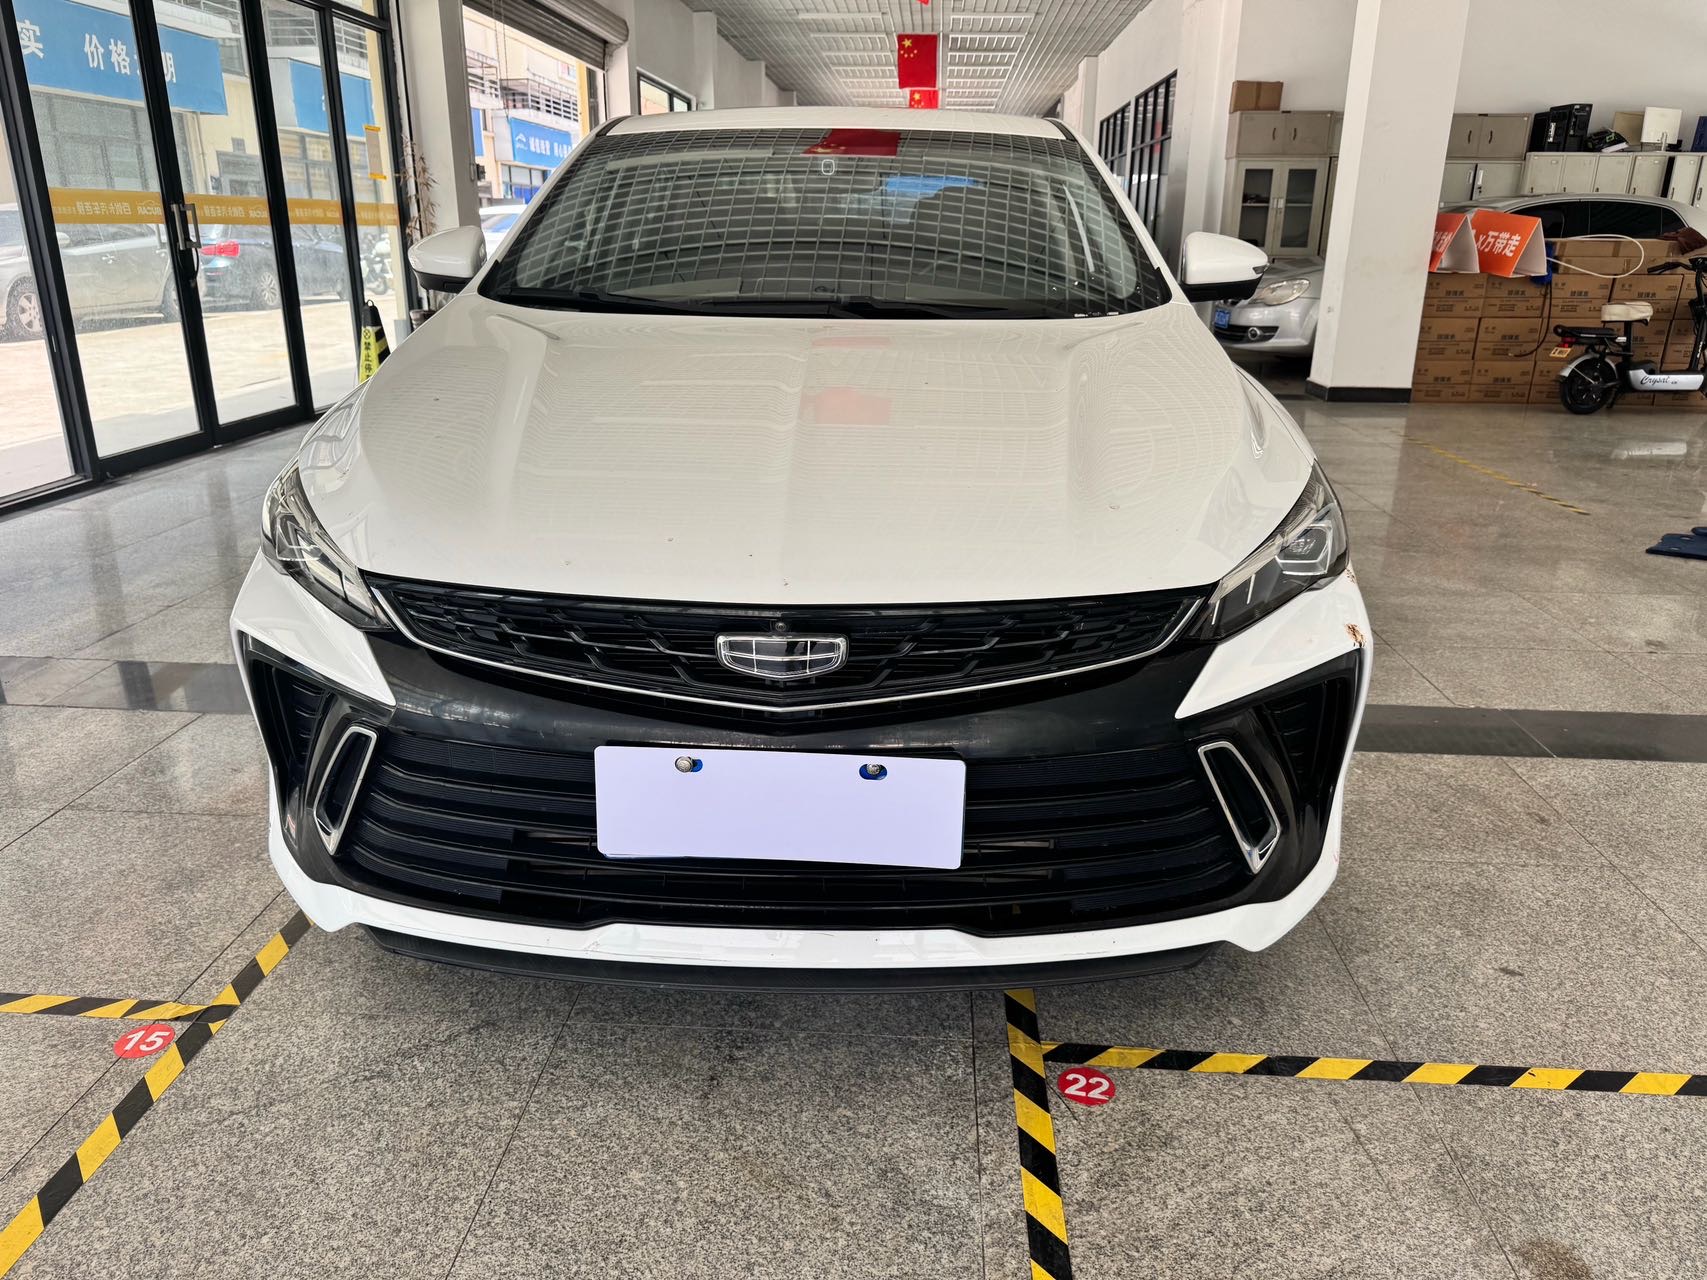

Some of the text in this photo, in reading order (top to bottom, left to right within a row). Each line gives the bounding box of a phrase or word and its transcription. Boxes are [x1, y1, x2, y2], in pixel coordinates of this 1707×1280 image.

[84, 33, 177, 83] 价格明
[1471, 230, 1521, 257] x万带走
[123, 1030, 171, 1052] 15
[1064, 1073, 1110, 1100] 22
